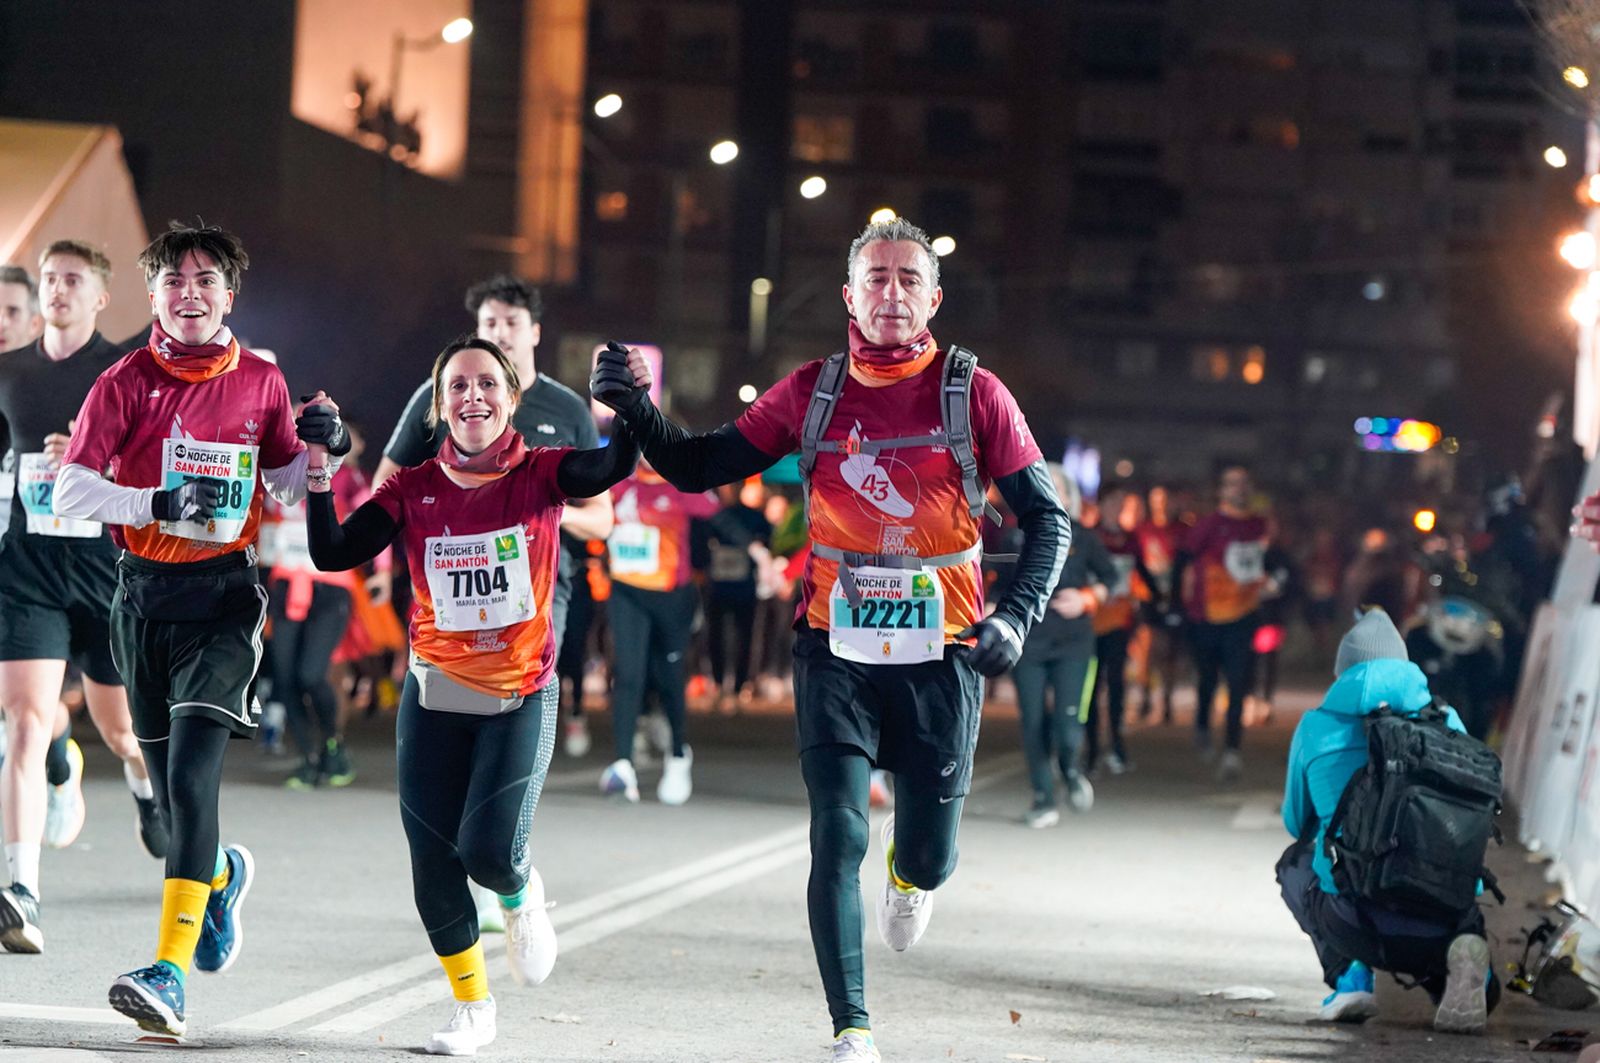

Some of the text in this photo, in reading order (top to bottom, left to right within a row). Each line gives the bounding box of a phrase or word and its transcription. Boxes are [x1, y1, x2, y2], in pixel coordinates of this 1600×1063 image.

[187, 451, 218, 463] NOCHE
[220, 454, 232, 464] DE
[174, 460, 195, 473] SAN
[195, 463, 231, 477] ANTÓN
[860, 474, 889, 501] 43
[444, 546, 472, 556] NOCHE
[474, 544, 487, 555] DE
[435, 555, 489, 569] SAN ANTÓN
[447, 565, 509, 598] 7704
[855, 577, 902, 588] NOCHE DE
[866, 588, 902, 599] ANTÓN
[456, 596, 507, 607] MARÍA DEL MAR
[847, 600, 927, 629] 12221
[876, 630, 895, 638] Paco
